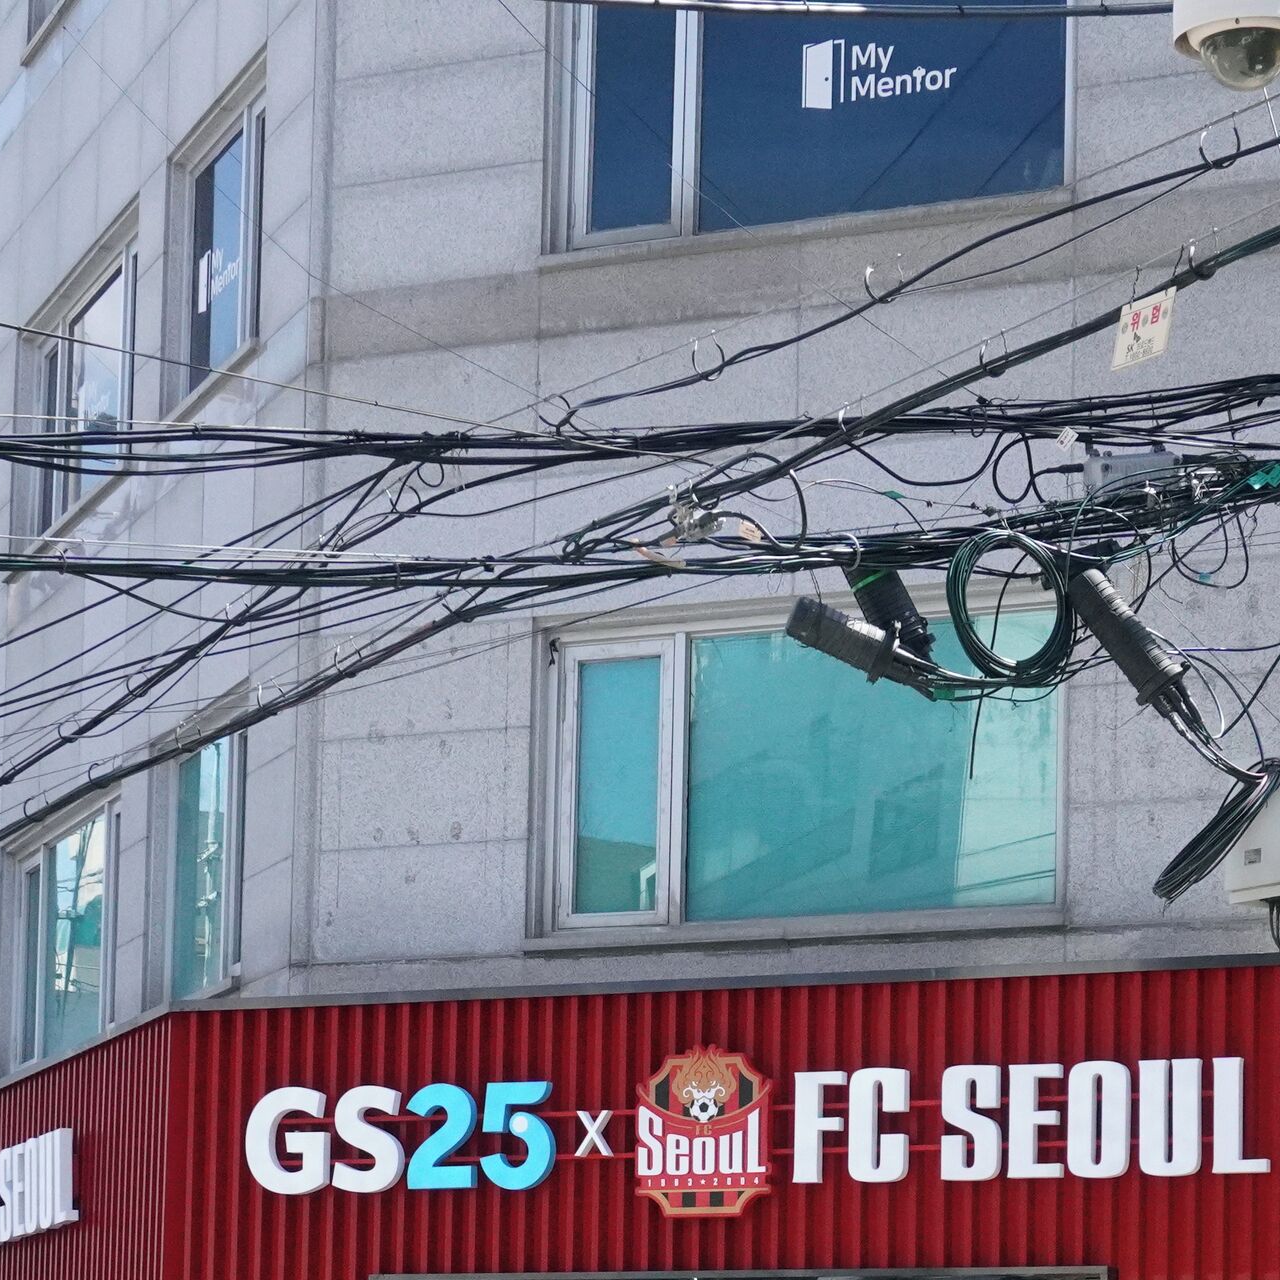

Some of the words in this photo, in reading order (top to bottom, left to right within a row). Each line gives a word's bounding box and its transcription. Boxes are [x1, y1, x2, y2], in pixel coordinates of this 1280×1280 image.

[851, 42, 895, 73] My
[851, 65, 957, 102] Mentor
[244, 1081, 557, 1195] GS25
[792, 1067, 910, 1184] FC
[940, 1057, 1271, 1182] SEOUL
[0, 1127, 80, 1243] SEOUL
